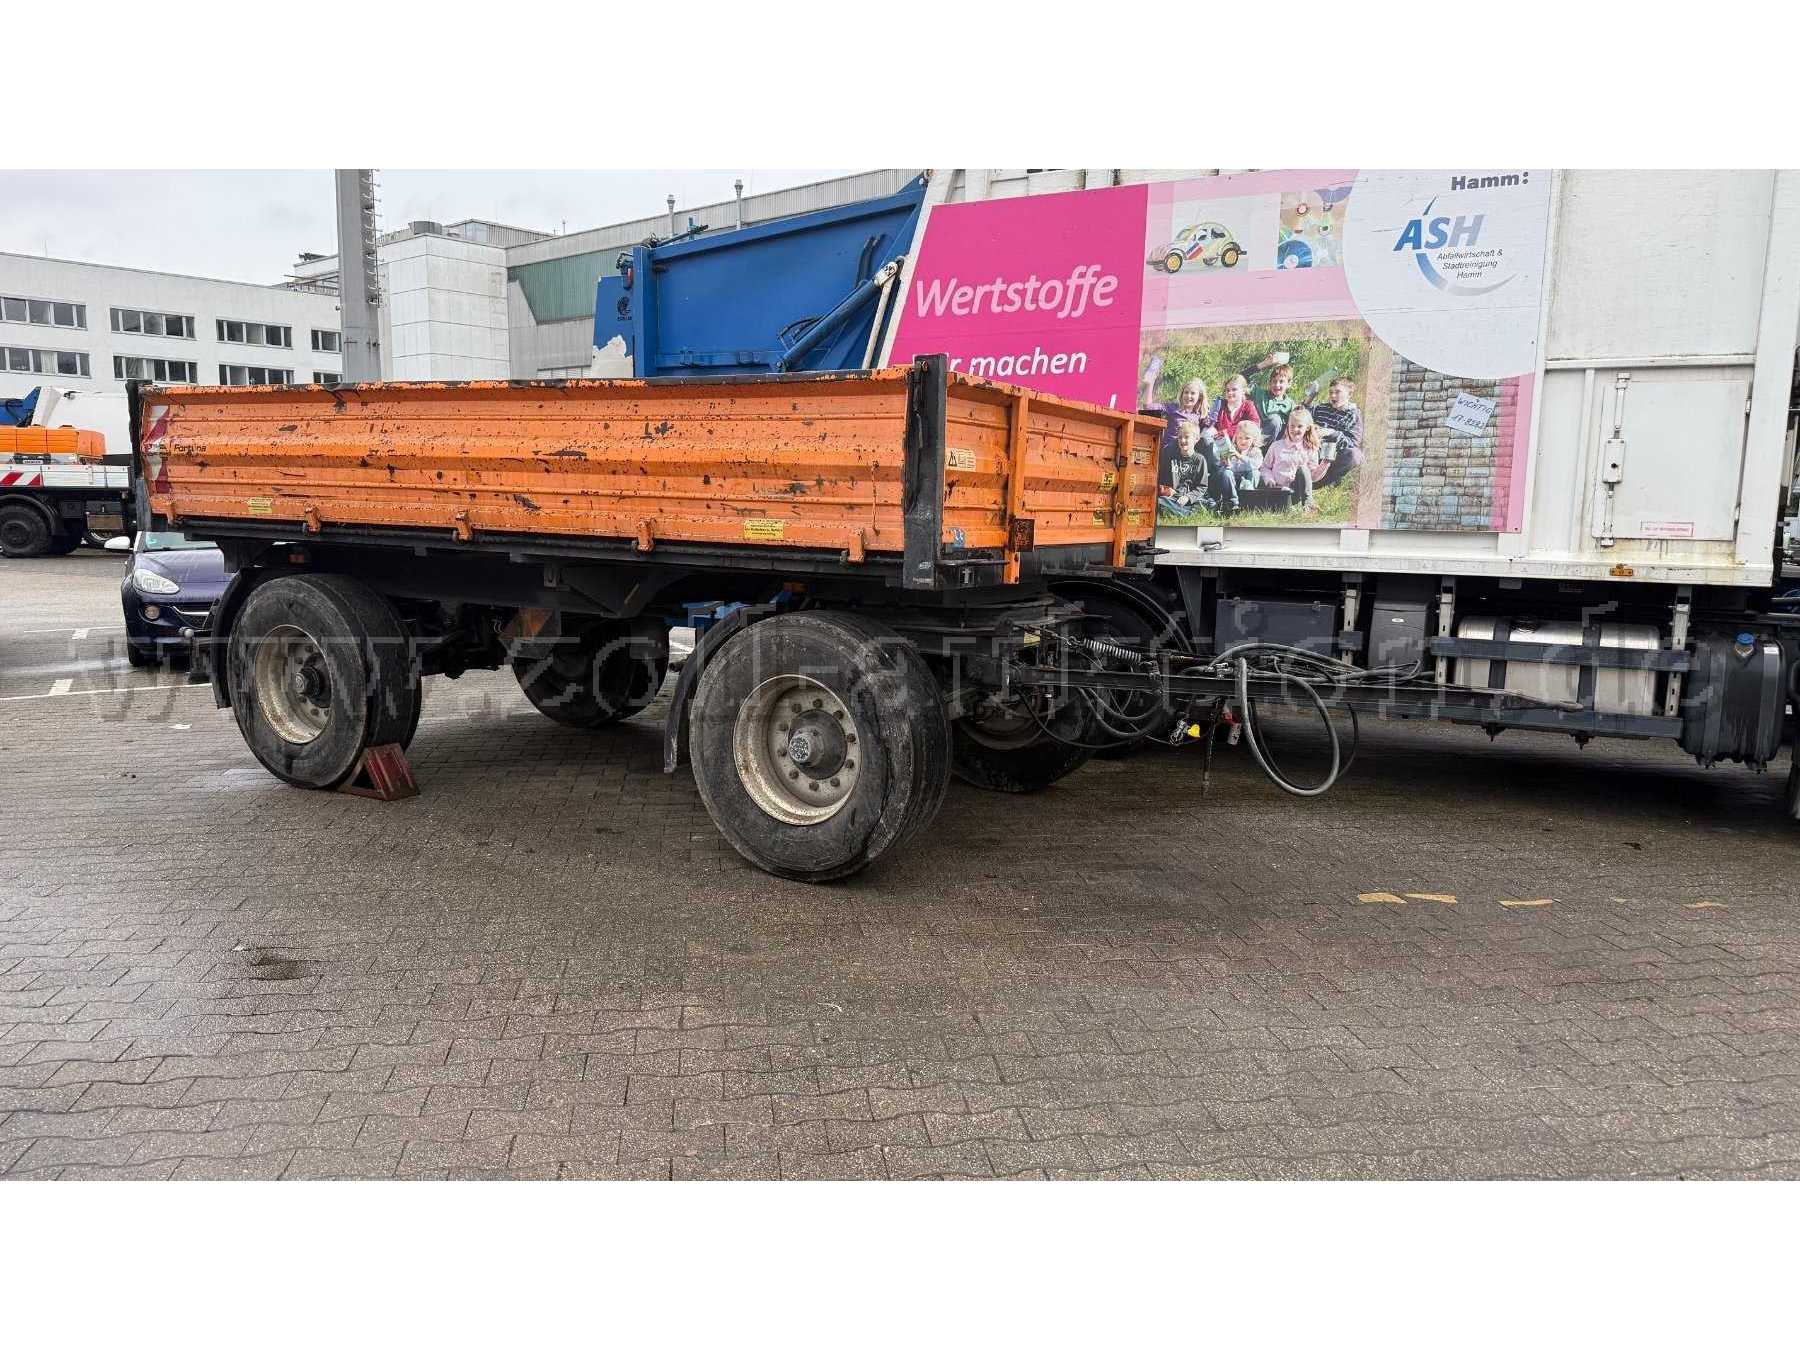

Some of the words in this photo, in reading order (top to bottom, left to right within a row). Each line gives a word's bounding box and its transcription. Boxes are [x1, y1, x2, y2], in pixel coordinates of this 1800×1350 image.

[1451, 172, 1529, 190] Hamm:
[1393, 214, 1486, 251] ASH
[1437, 249, 1495, 260] Abfallwirtschaft
[1496, 249, 1503, 257] &
[1442, 260, 1498, 270] Stadtreinigung
[1456, 271, 1482, 279] Hamm
[916, 265, 1118, 318] Wertstoffe
[970, 347, 1087, 377] machen
